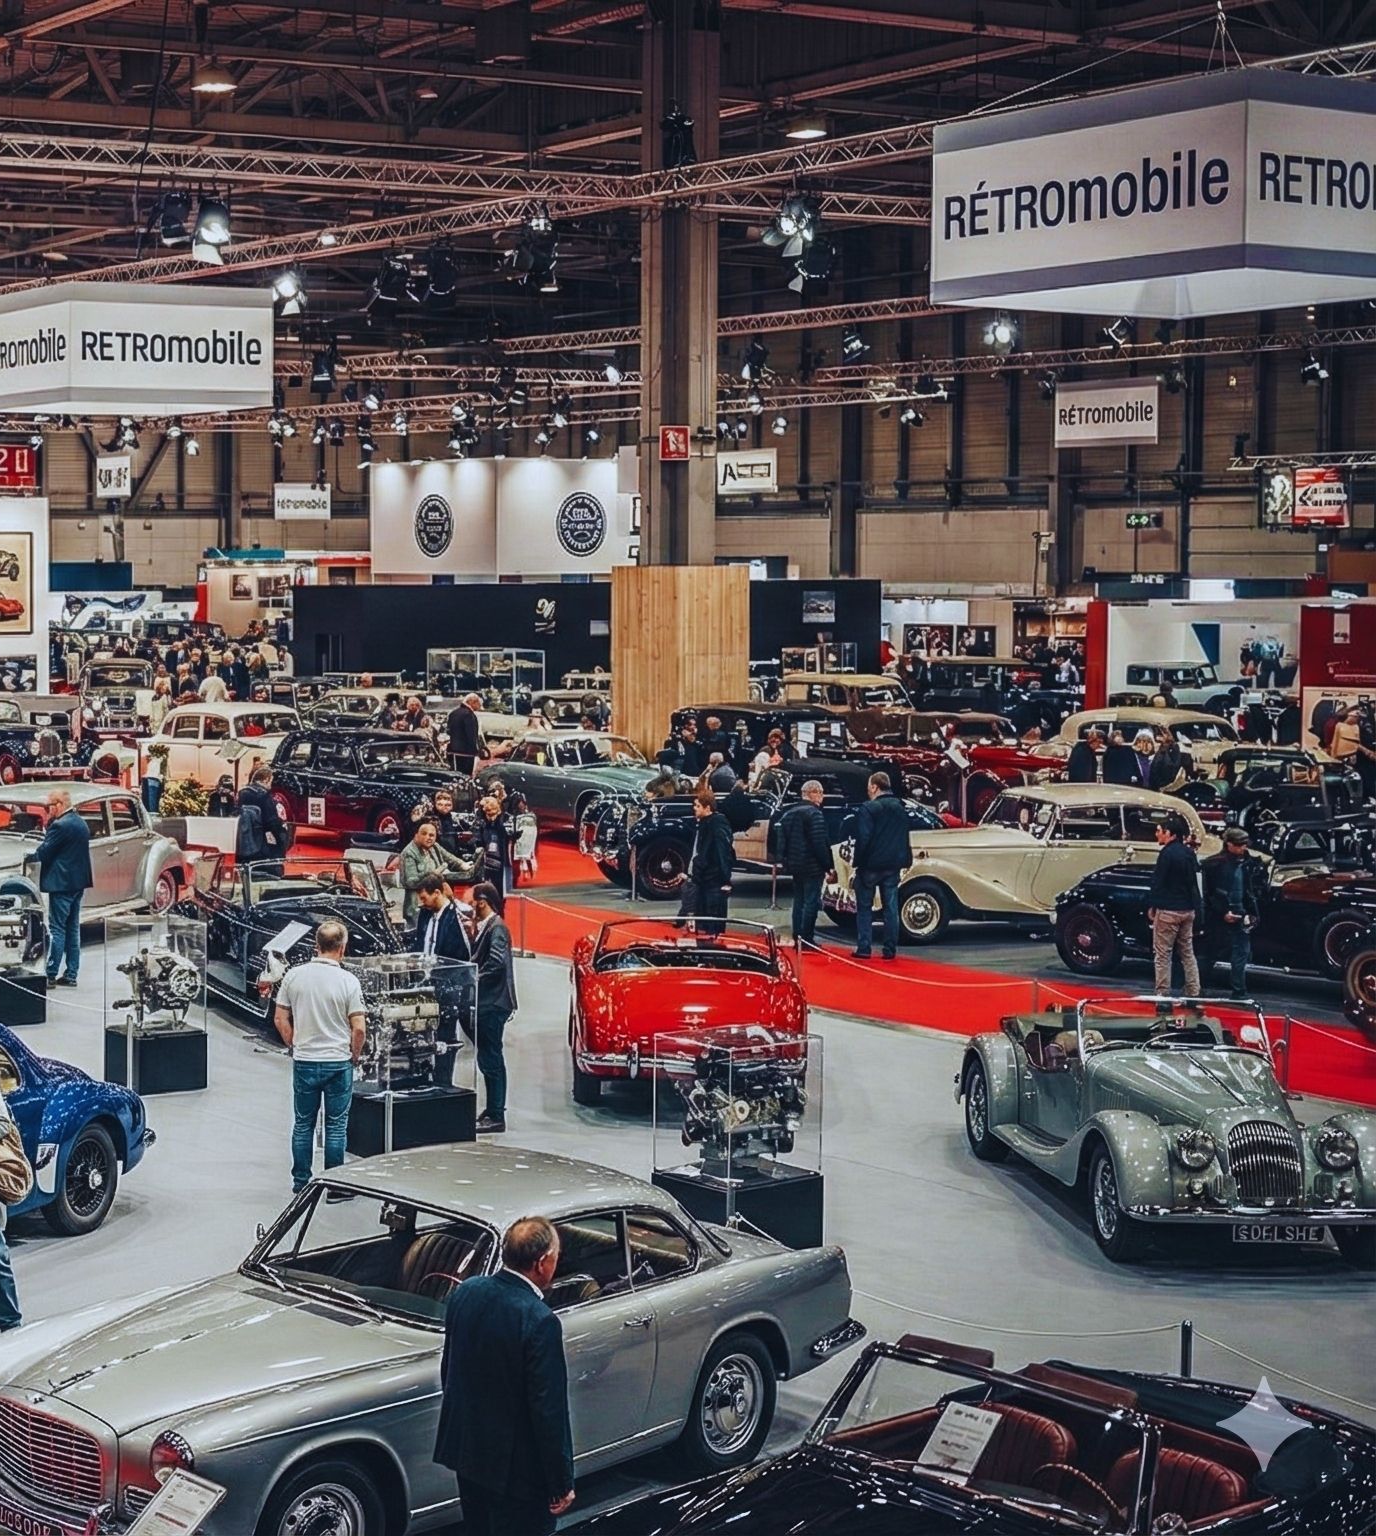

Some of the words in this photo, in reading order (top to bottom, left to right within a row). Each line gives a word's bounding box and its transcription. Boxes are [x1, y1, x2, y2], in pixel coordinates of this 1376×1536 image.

[944, 149, 1229, 240] RÉTROmobile
[1260, 152, 1376, 210] RETRO
[81, 329, 262, 366] RETROmobile
